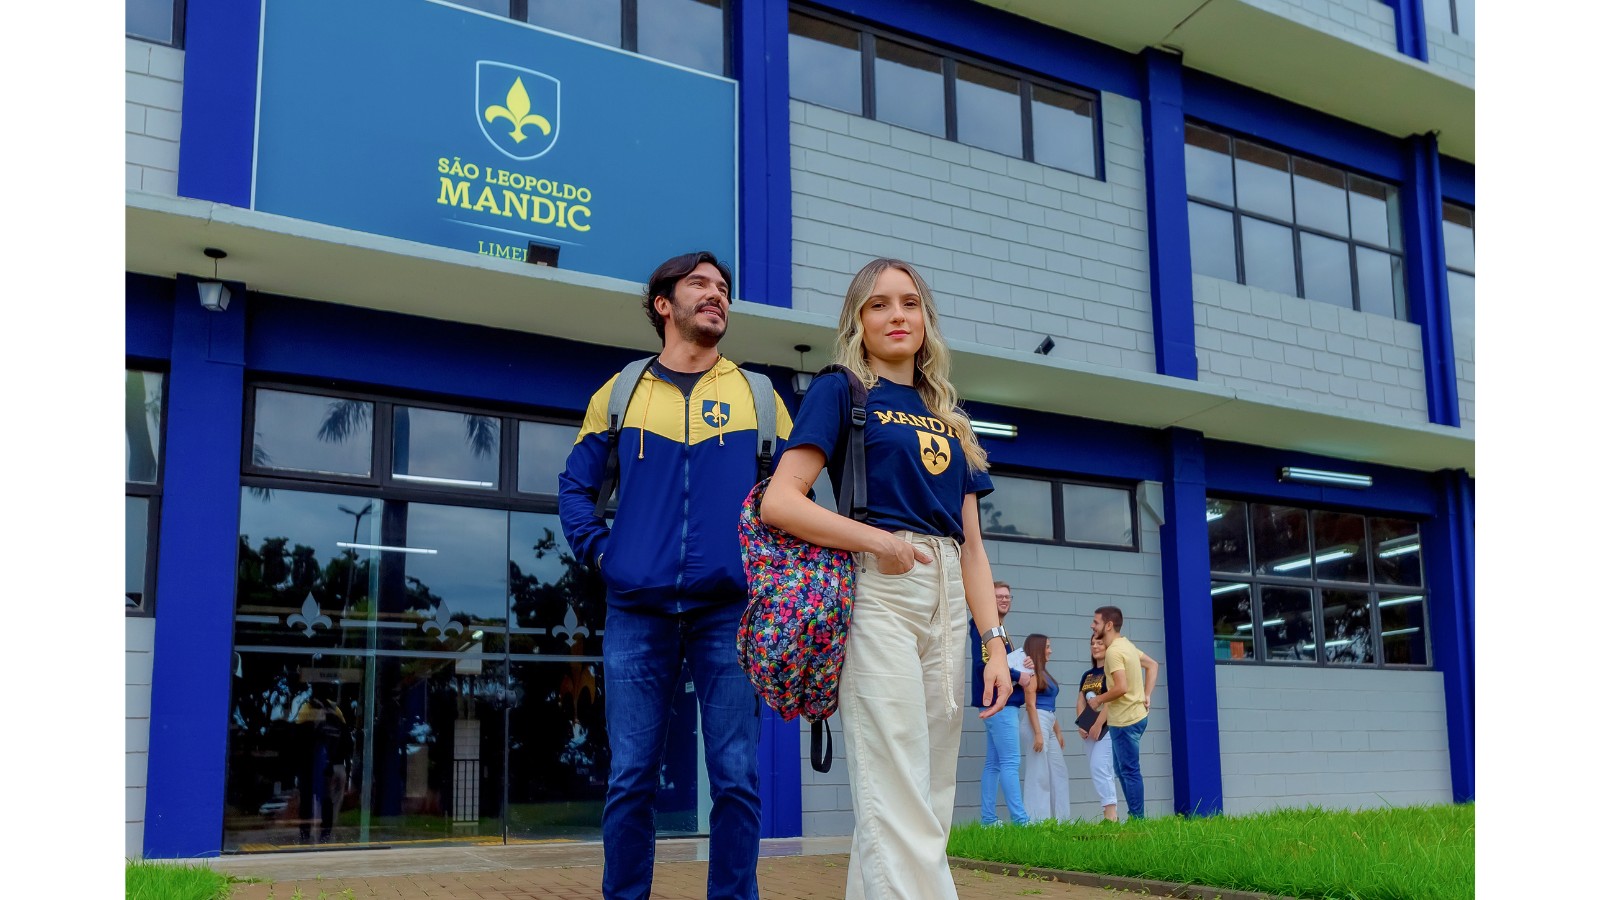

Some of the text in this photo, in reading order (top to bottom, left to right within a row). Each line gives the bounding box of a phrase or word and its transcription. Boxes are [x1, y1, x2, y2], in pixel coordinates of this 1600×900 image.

[436, 176, 592, 232] MANDIC
[437, 156, 592, 203] SÃO LEOPOLDO
